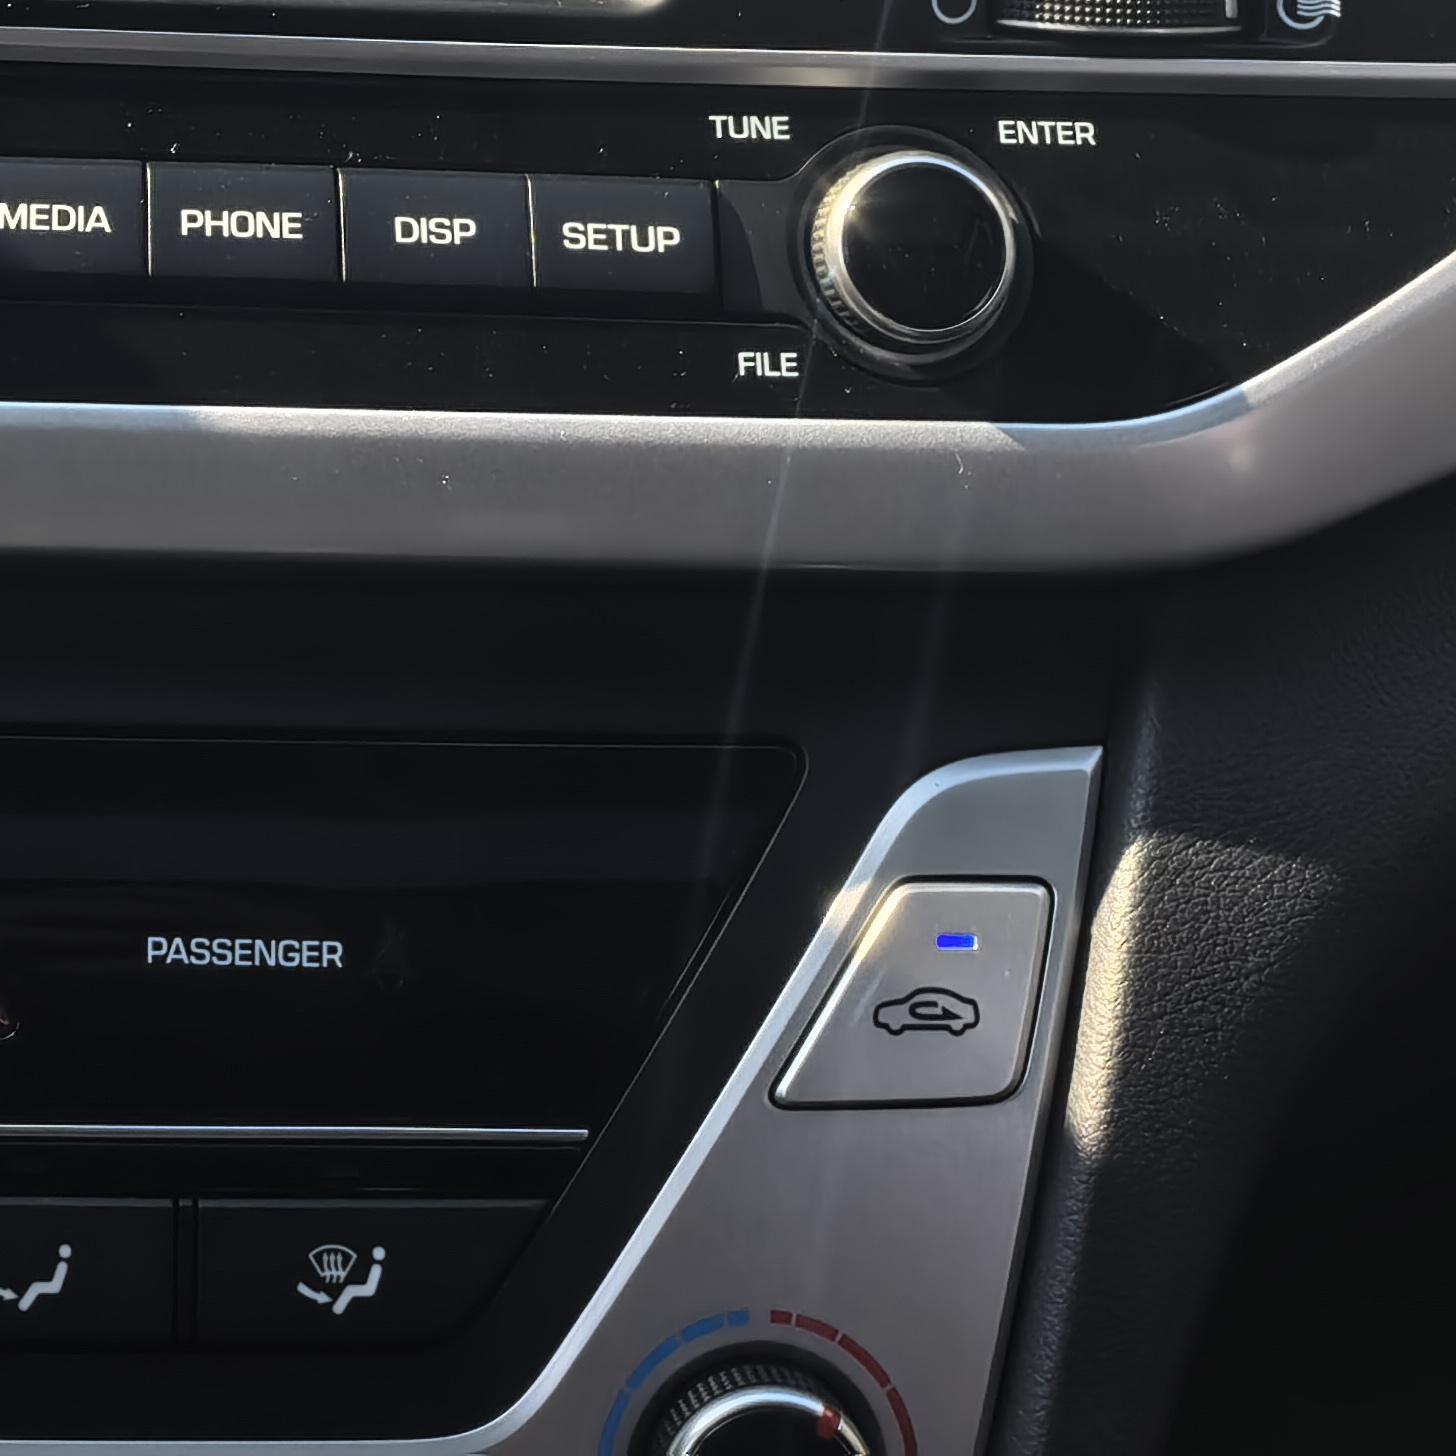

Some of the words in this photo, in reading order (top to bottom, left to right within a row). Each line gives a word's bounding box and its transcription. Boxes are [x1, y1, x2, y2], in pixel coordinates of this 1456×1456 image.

[707, 114, 792, 142] TUNE
[996, 118, 1098, 147] ENTER
[179, 207, 305, 241] PHONE
[393, 215, 478, 246] DISP
[561, 220, 682, 254] SETUP
[736, 350, 800, 379] FILE
[146, 935, 344, 970] PASSENGER
